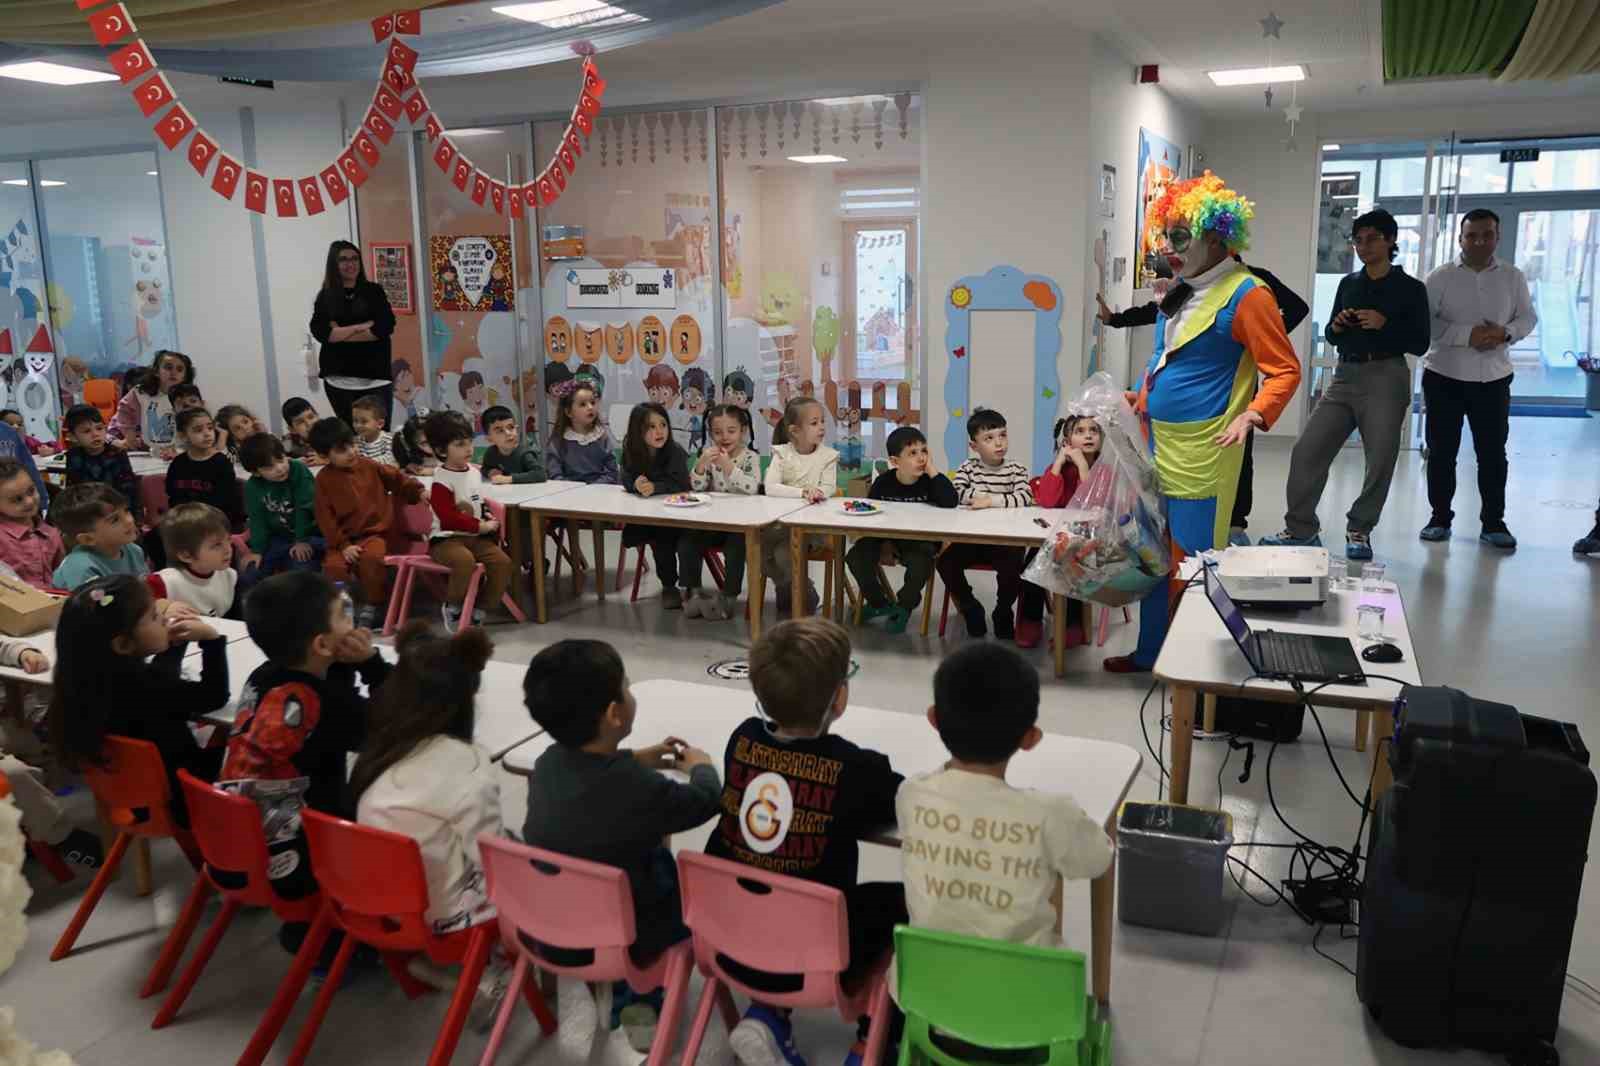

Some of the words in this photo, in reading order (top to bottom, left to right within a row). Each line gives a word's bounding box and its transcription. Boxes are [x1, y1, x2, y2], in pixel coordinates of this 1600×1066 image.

[914, 805, 960, 833] TOO
[971, 817, 1040, 844] BUSY
[1002, 856, 1041, 878] THE
[925, 874, 1013, 909] WORLD
